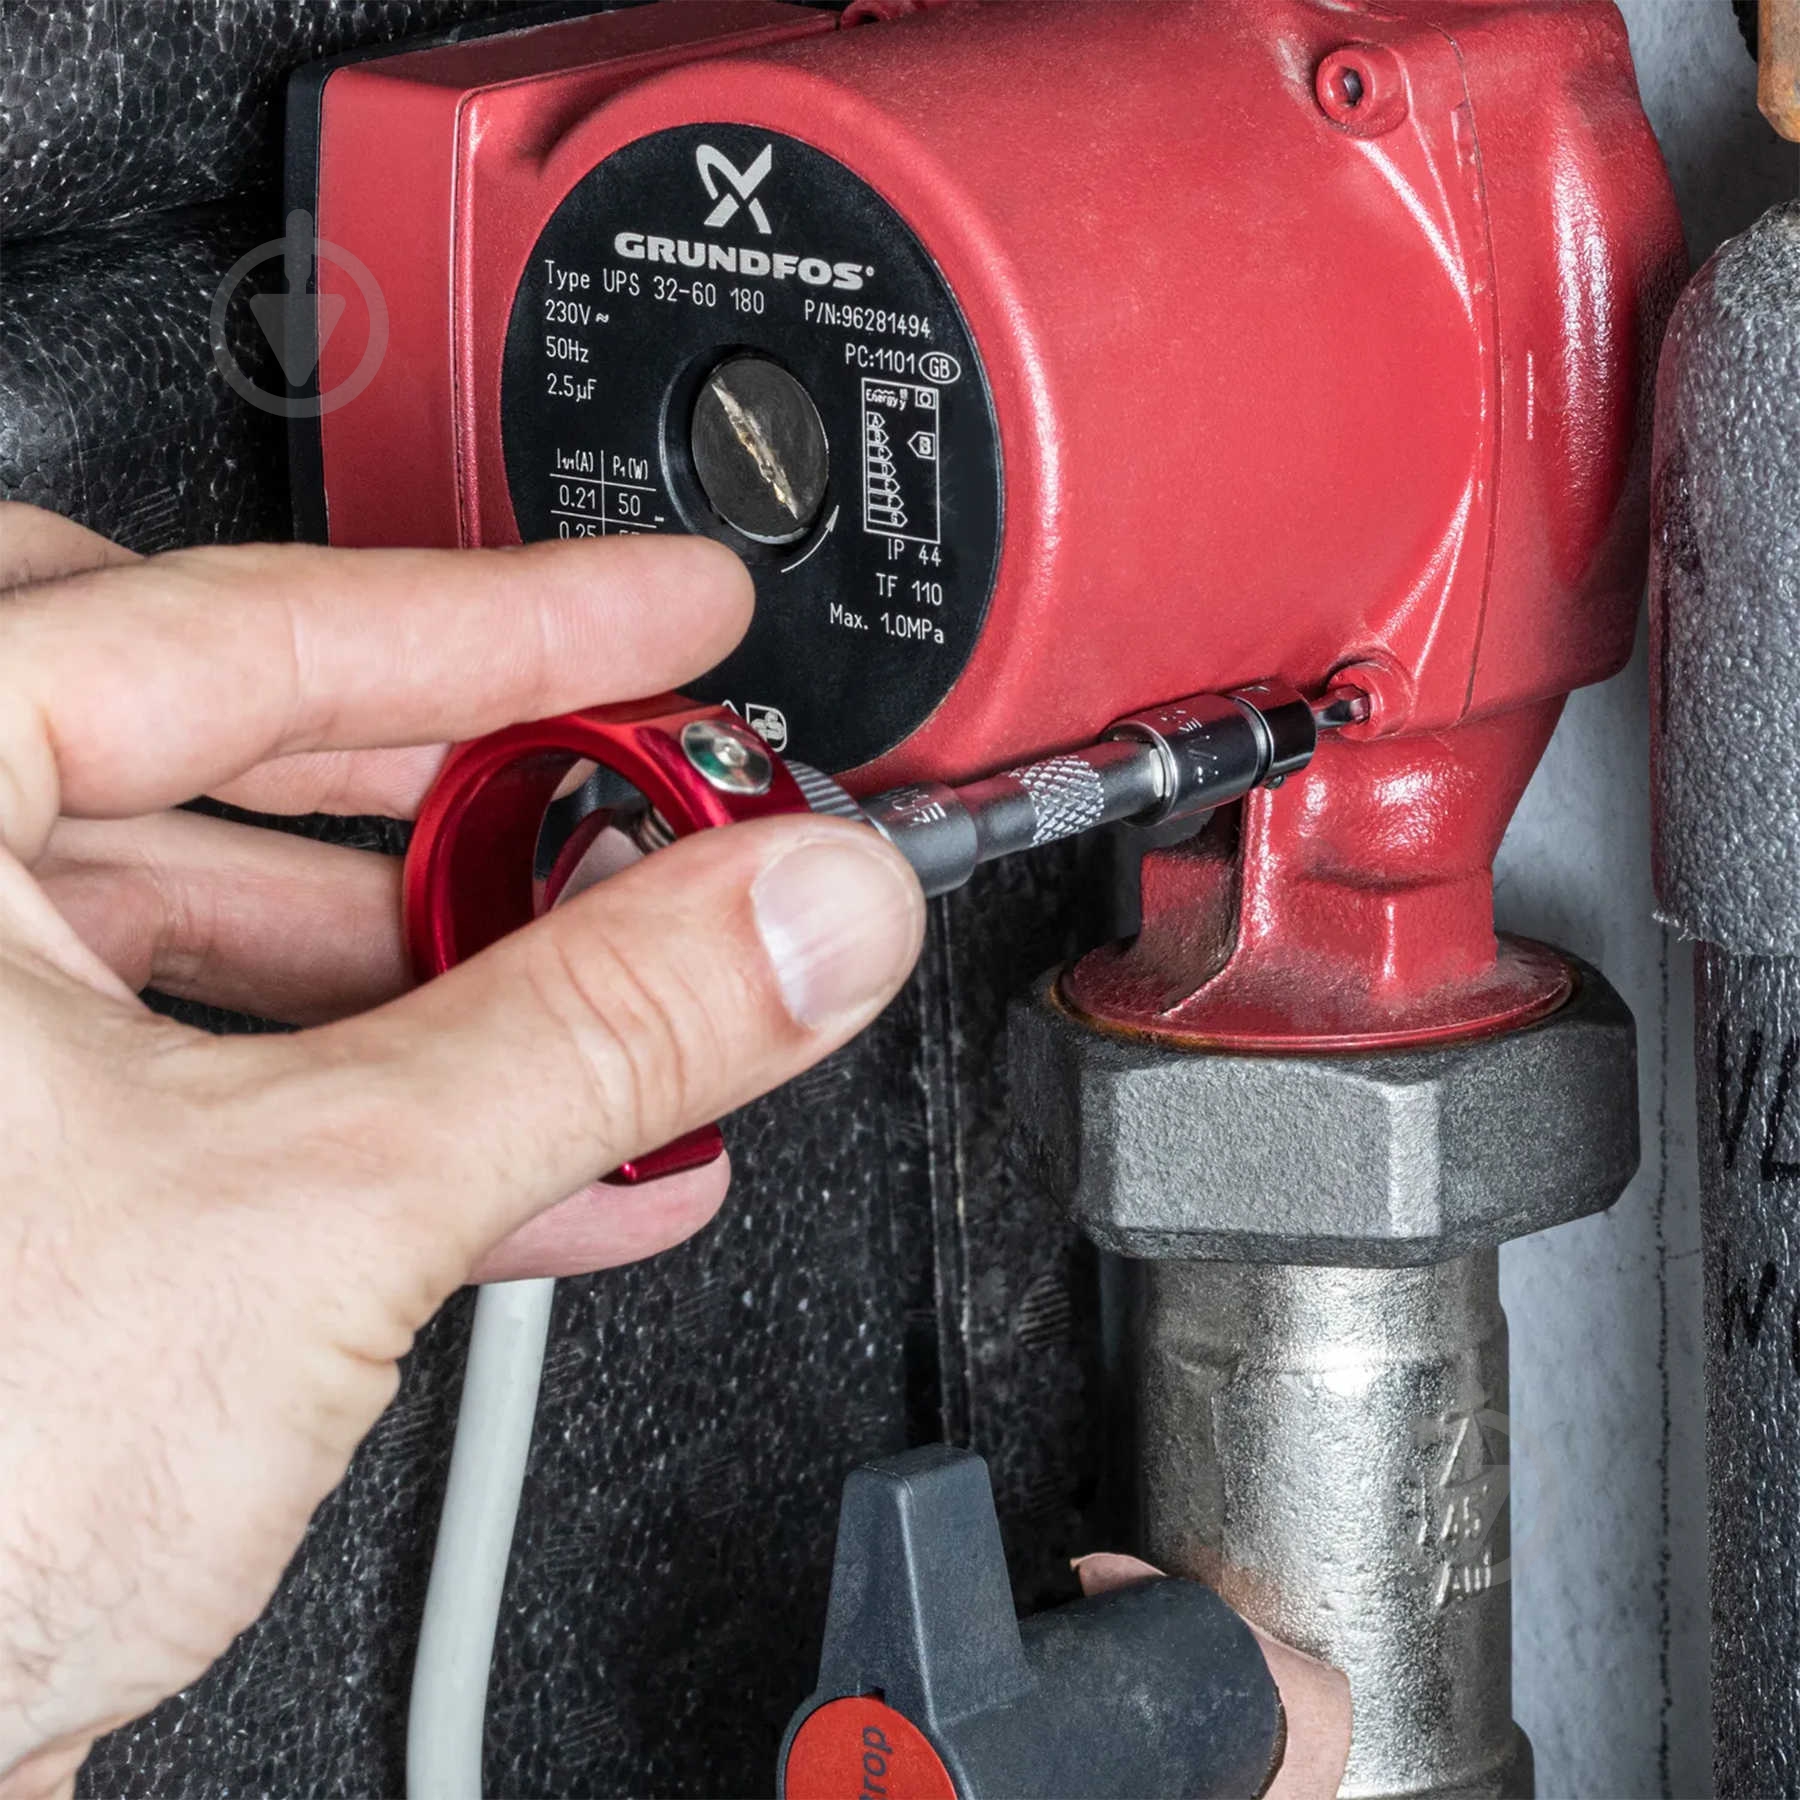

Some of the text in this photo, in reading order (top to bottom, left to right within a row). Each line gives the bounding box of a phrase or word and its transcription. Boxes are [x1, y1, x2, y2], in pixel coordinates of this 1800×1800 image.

[614, 232, 864, 291] GRUNDFOS
[545, 260, 765, 315] Type UPS 32-60 180
[804, 299, 931, 338] P/N:96281494
[546, 337, 589, 364] 50Hz
[845, 343, 915, 375] PC:1101
[929, 357, 950, 379] GB
[559, 484, 641, 517] 0.21 50
[888, 538, 942, 567] IP 44
[876, 572, 943, 606] TF 110
[830, 602, 944, 644] Max. 1.0MPa
[858, 1726, 894, 1800] rop
